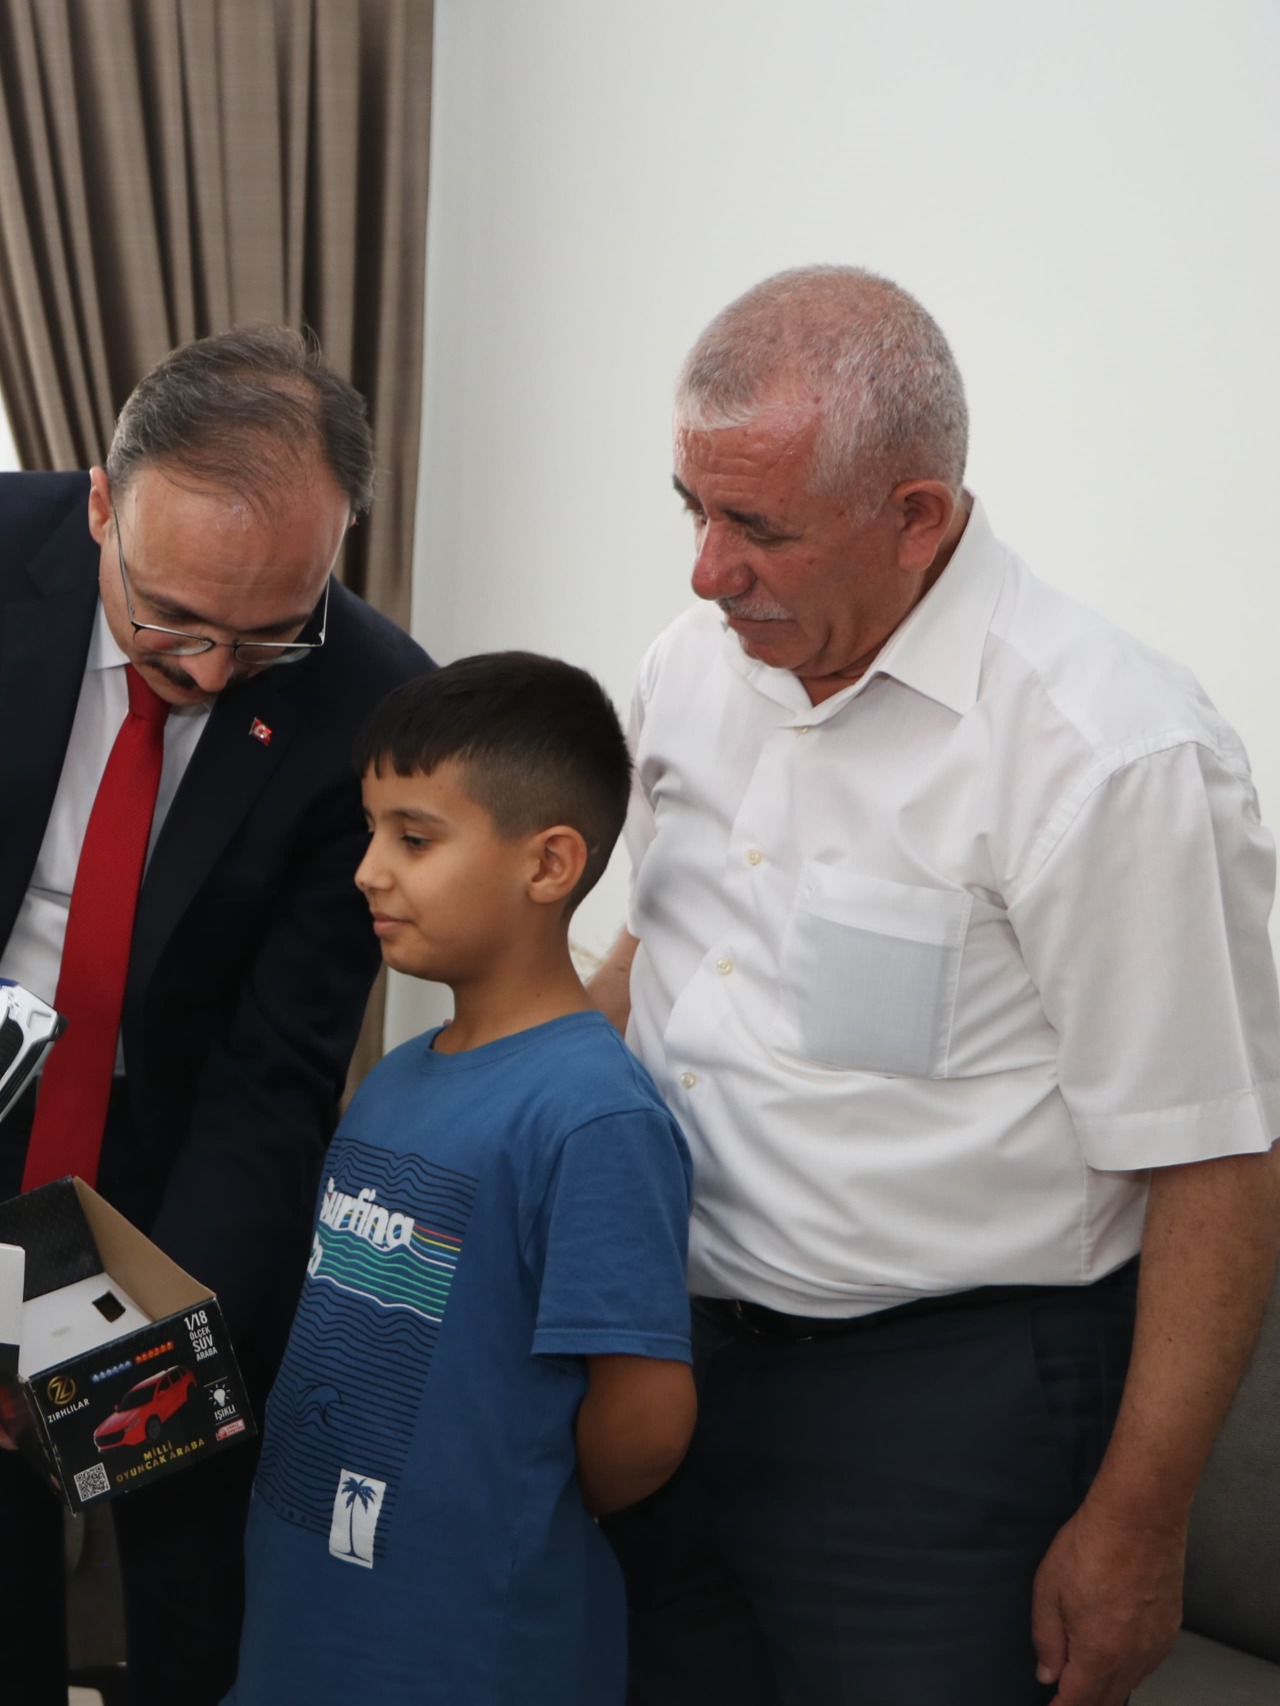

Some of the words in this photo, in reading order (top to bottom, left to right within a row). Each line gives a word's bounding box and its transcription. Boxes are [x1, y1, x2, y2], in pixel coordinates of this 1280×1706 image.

[184, 1310, 208, 1331] 1/18
[189, 1325, 211, 1341] ÖLÇEK
[192, 1334, 214, 1353] SUV
[196, 1346, 218, 1362] ARABA
[47, 1398, 90, 1424] ZIRHLILAR
[116, 1455, 168, 1483] OYUNCAK
[170, 1437, 206, 1460] ARABA
